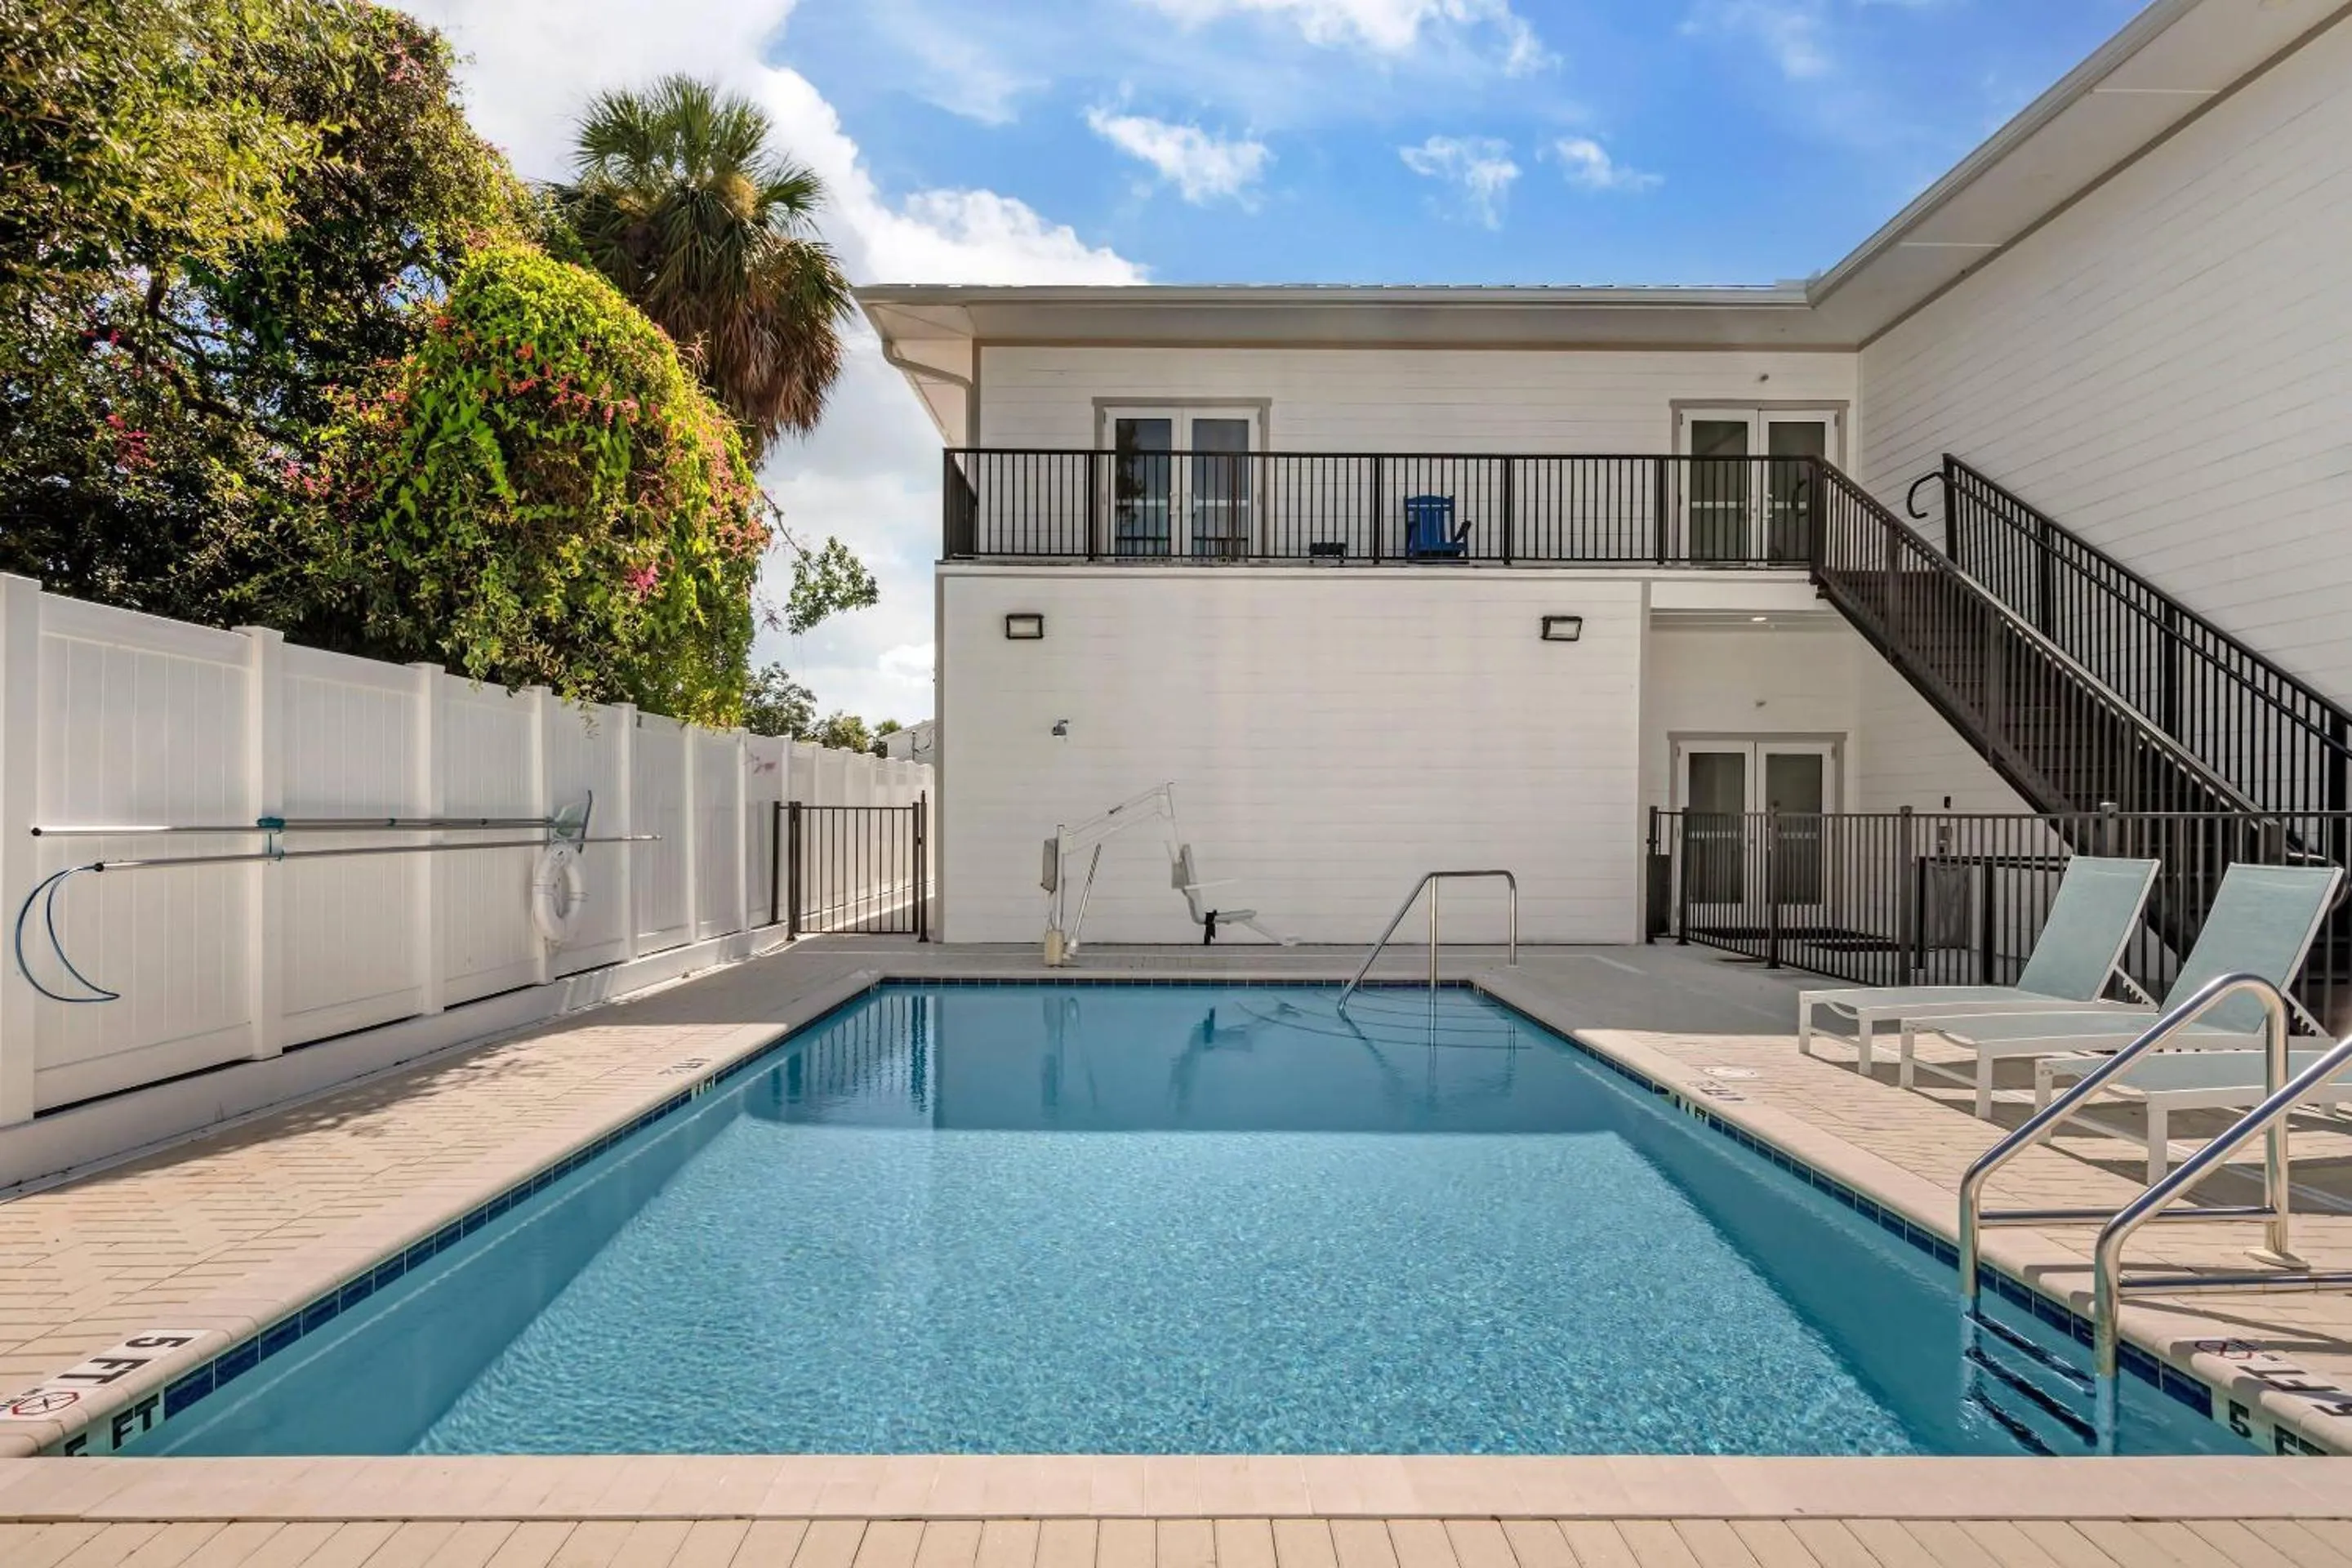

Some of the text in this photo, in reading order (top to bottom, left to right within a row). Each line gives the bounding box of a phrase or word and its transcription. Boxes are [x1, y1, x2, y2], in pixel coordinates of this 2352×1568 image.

[57, 1337, 194, 1384] 5 FT
[2236, 1365, 2341, 1391] FT
[112, 1392, 159, 1450] FT
[2229, 1399, 2252, 1438] 5
